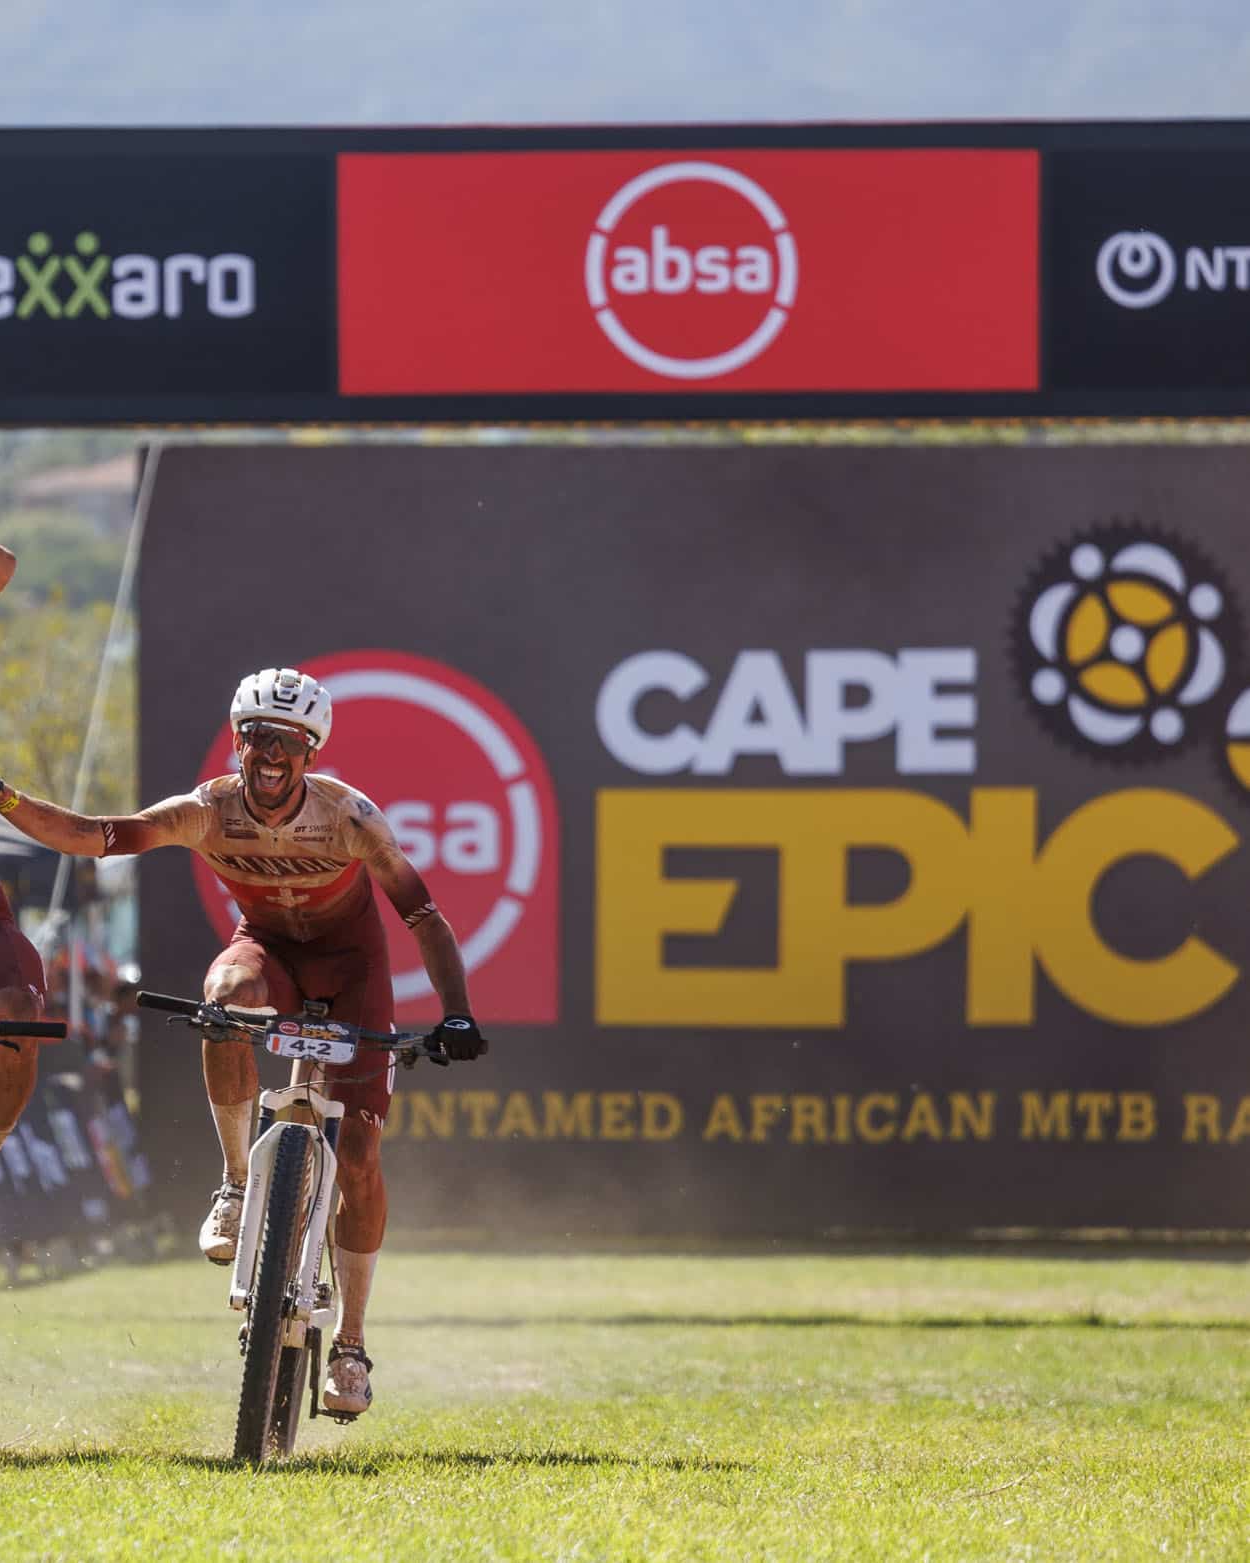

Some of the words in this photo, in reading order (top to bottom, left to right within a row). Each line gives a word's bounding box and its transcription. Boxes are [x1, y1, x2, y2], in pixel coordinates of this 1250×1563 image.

[611, 226, 773, 296] absa
[596, 648, 977, 777] CAPE
[596, 787, 1242, 1028] EPIC
[290, 1040, 331, 1056] 4-2
[702, 1092, 994, 1142] AFRICAN
[1021, 1090, 1156, 1140] MTB
